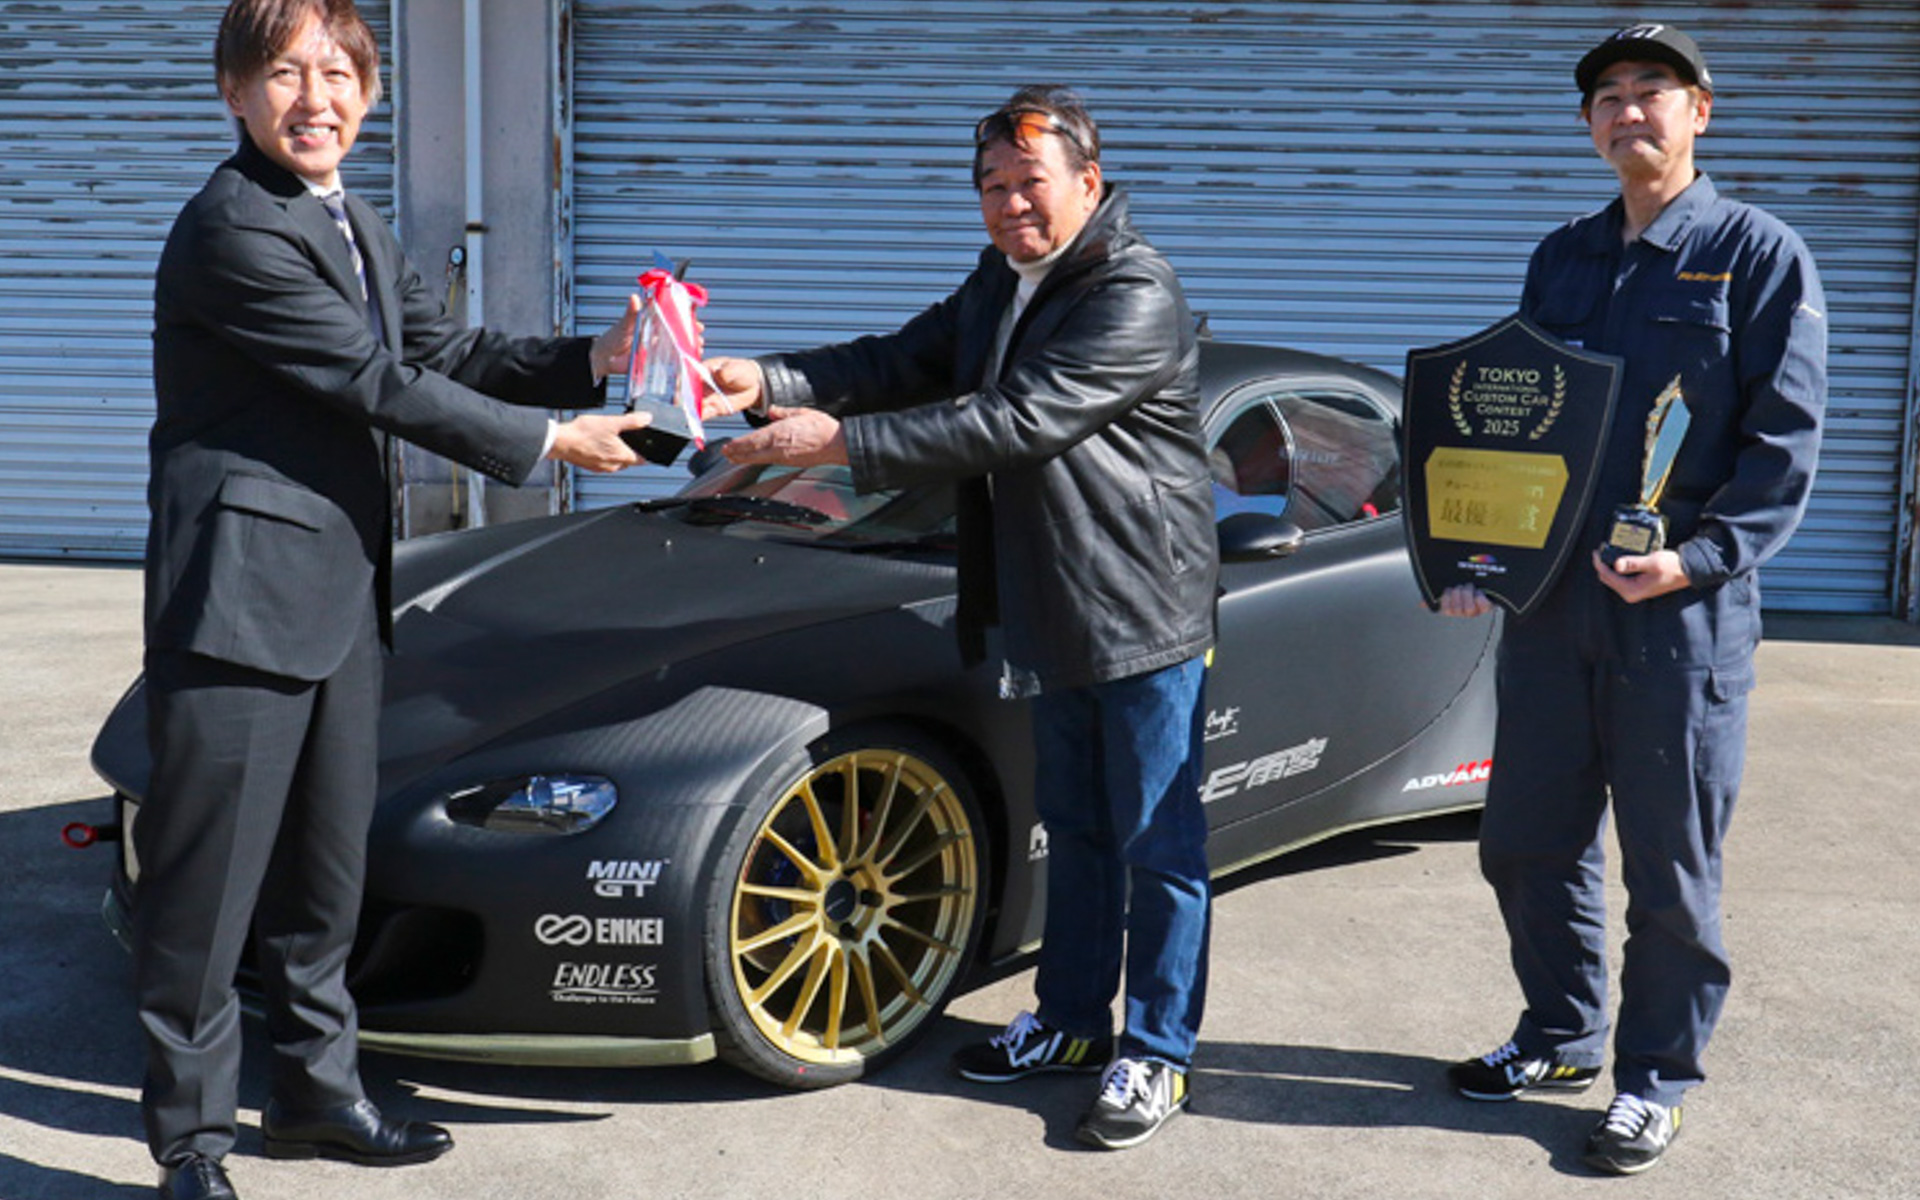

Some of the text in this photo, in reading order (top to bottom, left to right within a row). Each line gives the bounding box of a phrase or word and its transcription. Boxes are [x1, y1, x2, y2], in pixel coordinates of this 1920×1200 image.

[1478, 367, 1540, 384] TOKYO
[1462, 390, 1549, 406] CUSTOM CAR
[1476, 403, 1532, 416] CONTEST
[1482, 419, 1520, 436] 2025
[1402, 765, 1491, 792] ADVAN
[586, 860, 663, 879] MINI
[594, 879, 656, 897] GT
[596, 918, 664, 945] ENKEI
[553, 963, 657, 988] ENDLESS
[553, 993, 597, 1004] Challenge
[627, 995, 656, 1004] Future
